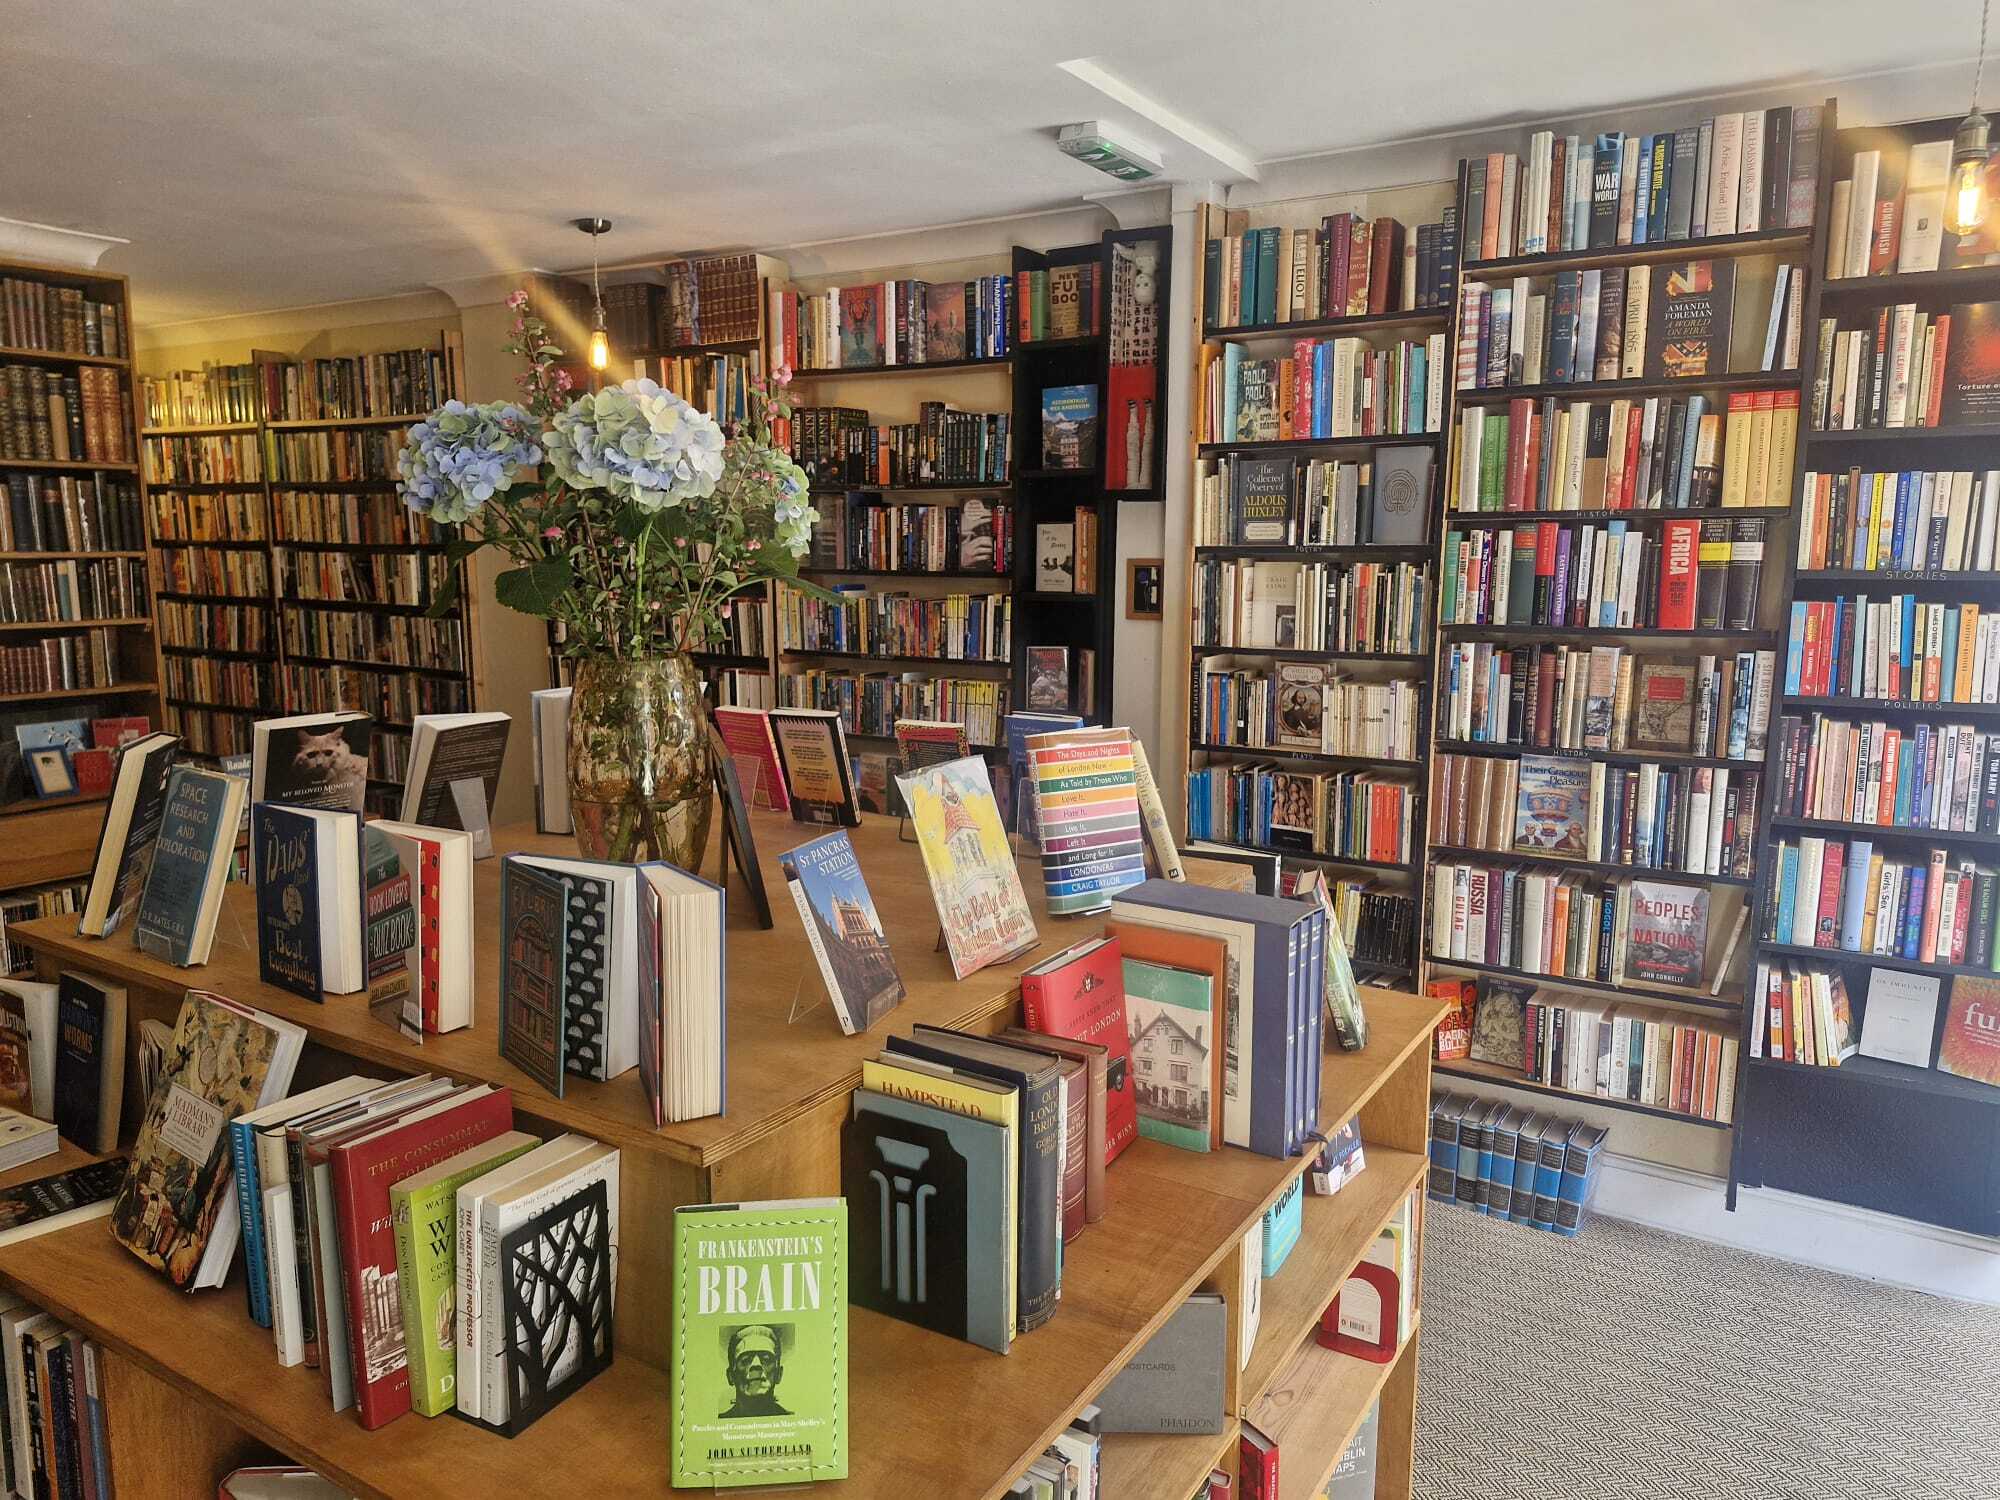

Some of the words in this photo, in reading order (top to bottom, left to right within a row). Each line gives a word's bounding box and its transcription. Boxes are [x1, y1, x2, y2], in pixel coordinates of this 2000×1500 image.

[1595, 173, 1618, 189] WAR
[1719, 171, 1730, 206] England
[1595, 190, 1618, 202] WORLD
[1879, 202, 1894, 255] COMMUNISM
[1295, 268, 1306, 299] ELIOT
[1052, 292, 1080, 305] BOO
[1667, 302, 1711, 312] AMANDA
[1665, 310, 1713, 320] FOREMAN
[1674, 319, 1711, 328] WORLD
[1667, 327, 1681, 335] ON
[1682, 326, 1708, 335] FIRE
[1247, 473, 1284, 484] Collected
[1256, 464, 1273, 474] The
[1246, 482, 1273, 493] Poetry
[1244, 495, 1287, 506] ALDOUS
[1244, 505, 1287, 517] HUXLEY
[1669, 526, 1692, 575] AFRICA
[1480, 560, 1489, 582] Dream
[1556, 554, 1567, 582] EASTERN
[1478, 583, 1487, 615] Shattered
[1554, 584, 1565, 616] CUSTOMS
[1763, 663, 1772, 676] SIX
[1759, 680, 1771, 698] DAYS
[1884, 701, 1942, 710] POLITICS
[1757, 711, 1768, 728] WAR
[1056, 751, 1069, 759] The
[1072, 749, 1085, 759] Days
[1086, 748, 1098, 757] and
[1100, 746, 1120, 756] Nights
[1964, 731, 1974, 755] BURNT
[1058, 767, 1066, 775] of
[1524, 765, 1549, 776] Their
[1990, 758, 1999, 773] TOM
[282, 790, 293, 798] MY
[294, 786, 323, 798] BELOVED
[323, 782, 354, 793] MONSTER
[1060, 780, 1069, 788] As
[1070, 777, 1083, 788] Told
[1084, 777, 1092, 787] by
[1094, 775, 1111, 785] Those
[1112, 774, 1127, 783] Who
[1988, 774, 1997, 795] BARRY
[179, 782, 208, 804] SPACE
[169, 803, 209, 825] RESEARCH
[176, 824, 196, 838] AND
[263, 817, 275, 833] The
[1064, 825, 1078, 833] Live
[156, 837, 208, 865] EXPLORATION
[811, 836, 851, 864] PANCRAS
[1066, 839, 1079, 847] Left
[818, 851, 855, 876] STATION
[1068, 853, 1080, 862] and
[1081, 851, 1097, 861] Long
[1098, 850, 1108, 859] for
[1108, 848, 1114, 857] It
[376, 863, 387, 879] The
[1069, 862, 1114, 877] LONDONERS
[1880, 871, 1892, 889] Girls
[1071, 880, 1096, 893] CRAIG
[1096, 876, 1121, 888] TAYLOR
[1469, 874, 1486, 916] RUSSIA
[369, 891, 385, 915] BOOK
[385, 879, 409, 910] LOVER'S
[1880, 895, 1891, 910] Sex
[1454, 895, 1466, 931] GULAG
[1635, 899, 1700, 921] PEOPLES
[373, 926, 389, 957] QUIZ
[389, 912, 412, 950] BOOK
[1633, 928, 1697, 951] NATIONS
[269, 952, 316, 990] Everything
[1640, 971, 1655, 980] JOHN
[1656, 972, 1684, 983] CONNELLY
[1091, 1008, 1121, 1036] LONDON
[64, 1024, 93, 1054] WORMS
[881, 1080, 982, 1117] HAMPSTEAD
[1042, 1085, 1059, 1103] OLD
[170, 1095, 215, 1128] MADMAN'S
[172, 1110, 208, 1138] LIBRARY
[1117, 1123, 1134, 1143] WINN
[236, 1144, 246, 1165] JANE
[367, 1156, 400, 1177] THE
[238, 1167, 248, 1189] EYRE
[1273, 1175, 1300, 1218] WORLD
[458, 1207, 466, 1229] JOHN
[457, 1230, 466, 1256] CAREY
[490, 1225, 498, 1268] SIMON
[698, 1236, 823, 1259] FRANKENSTEIN'S
[465, 1229, 474, 1290] UNEXPECTED
[697, 1261, 822, 1315] BRAIN
[486, 1279, 495, 1327] STRICTLY
[465, 1292, 474, 1348] PROFESSOR
[485, 1329, 495, 1374] ENGLISH
[1122, 1361, 1176, 1372] POSTCARDS
[67, 1377, 77, 1421] COETZEE
[1160, 1417, 1216, 1429] PHAIDON
[707, 1447, 735, 1460] JOHN
[740, 1443, 812, 1458] SUTHERLAND
